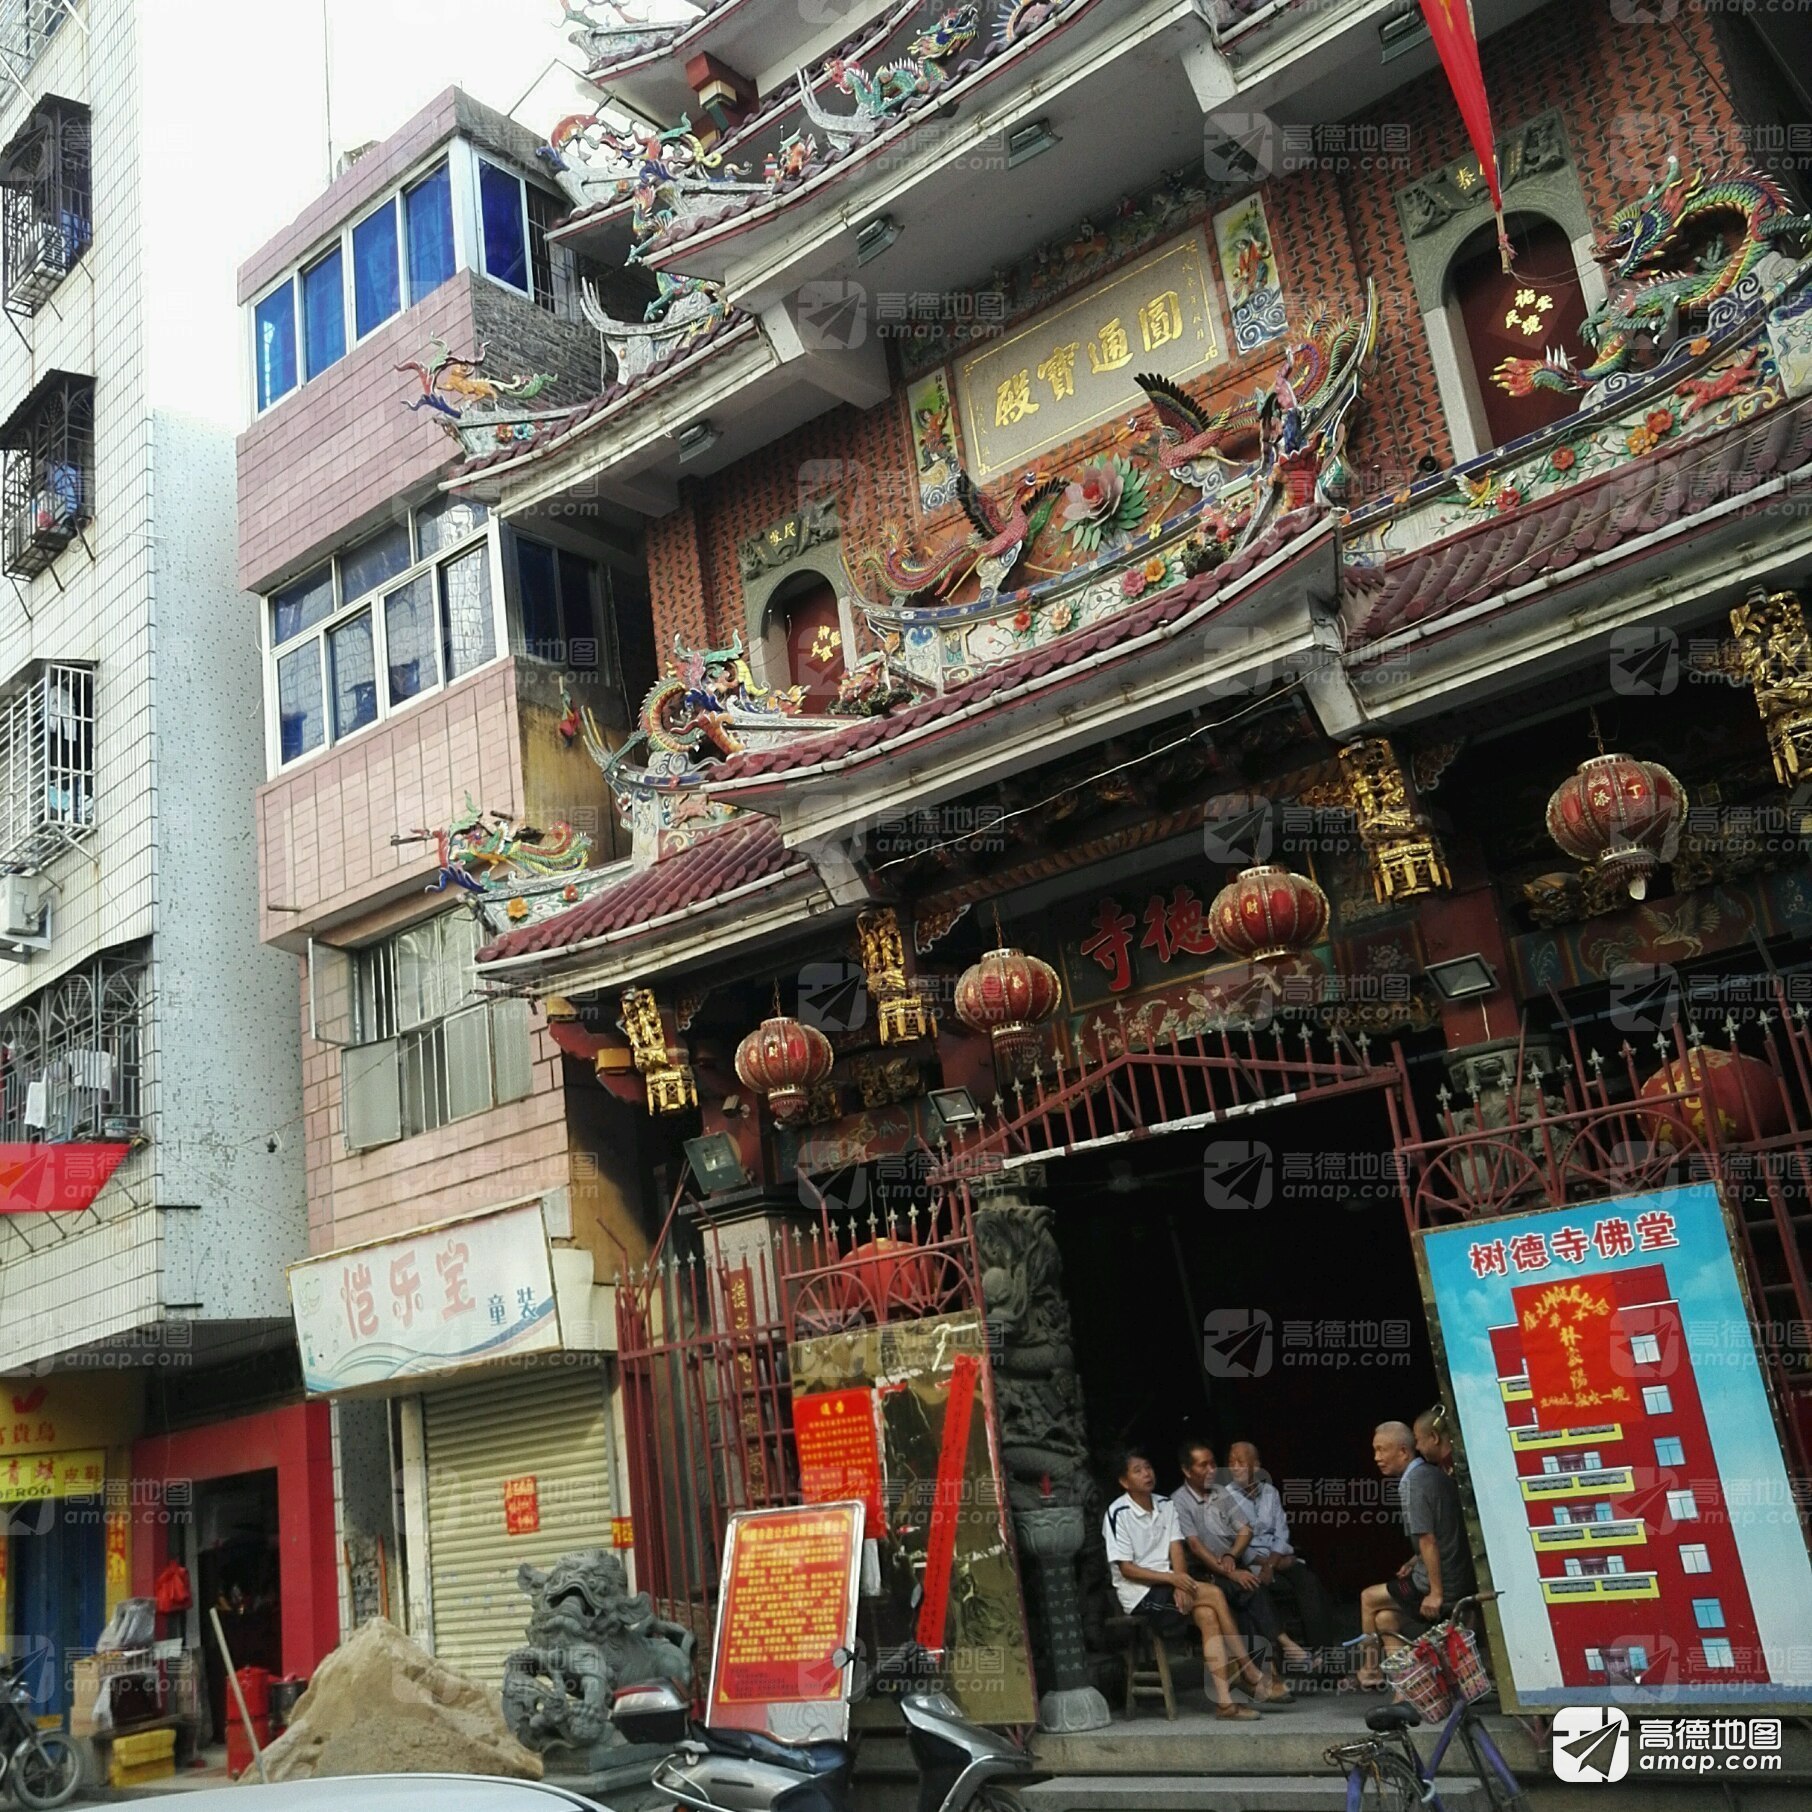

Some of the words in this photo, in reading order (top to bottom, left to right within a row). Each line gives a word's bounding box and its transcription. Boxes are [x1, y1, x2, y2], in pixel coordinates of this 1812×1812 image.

[995, 290, 1183, 427] 圓通寶殿
[1469, 1210, 1680, 1278] 树德寺佛堂
